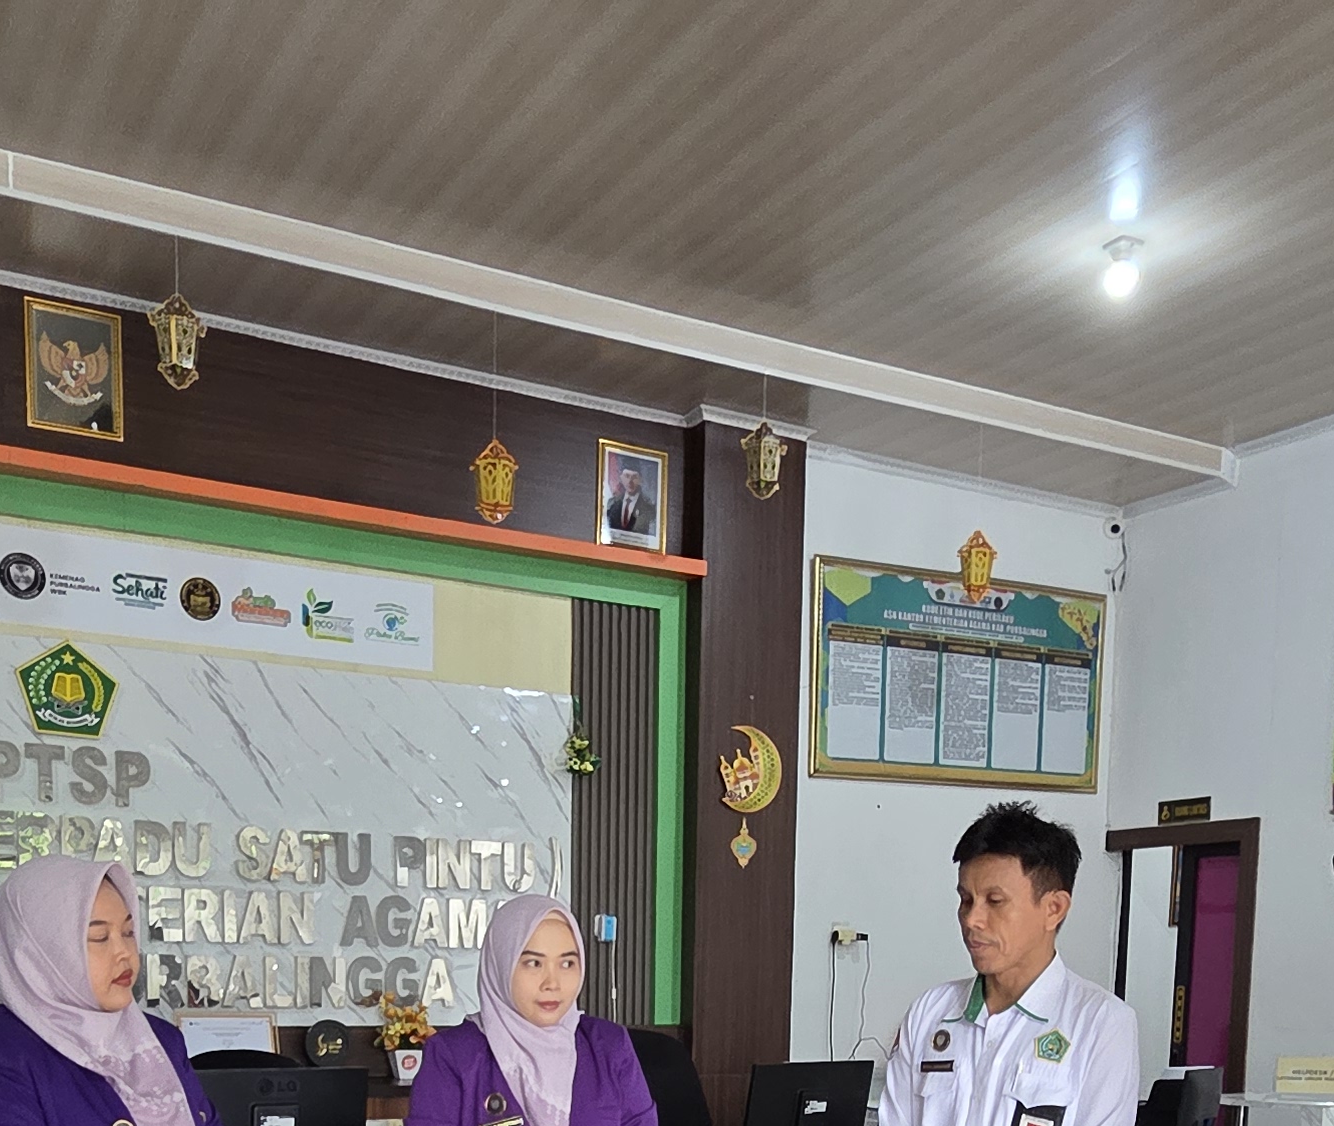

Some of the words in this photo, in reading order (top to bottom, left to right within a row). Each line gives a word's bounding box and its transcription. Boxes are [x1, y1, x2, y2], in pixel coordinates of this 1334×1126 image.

[112, 573, 167, 601] Sehati
[234, 824, 372, 885] SATU
[392, 835, 536, 894] PINTU
[339, 895, 507, 950] AGAM
[276, 1080, 298, 1093] LG
